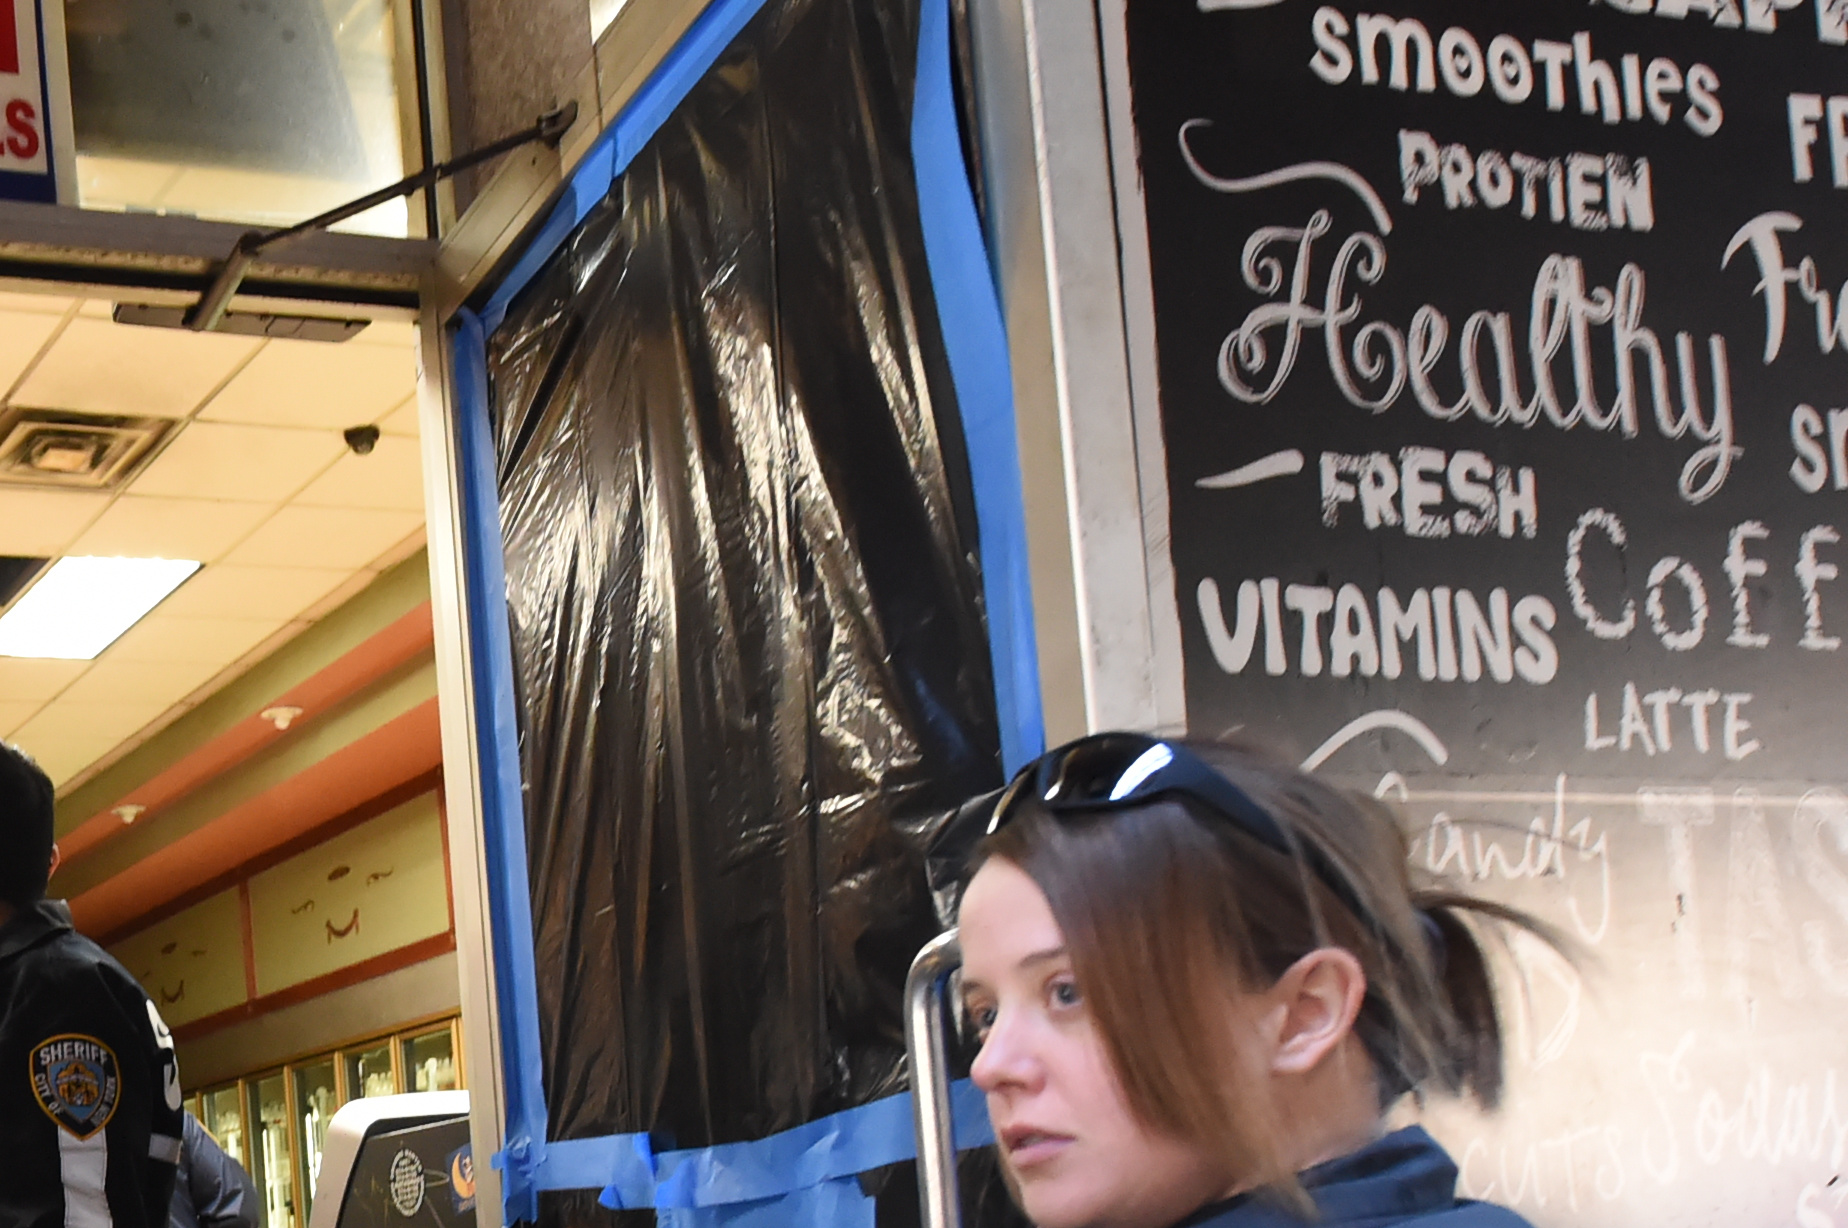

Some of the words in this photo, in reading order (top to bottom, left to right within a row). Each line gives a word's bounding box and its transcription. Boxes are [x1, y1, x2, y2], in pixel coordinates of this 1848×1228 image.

[1398, 128, 1654, 233] PROTIEN
[1217, 208, 1744, 505] Healthy
[1319, 446, 1538, 539] FRESH
[1196, 576, 1559, 685] VITAMINS
[1584, 680, 1762, 762] LATTE
[34, 1072, 53, 1099] CITY
[48, 1101, 63, 1117] OF
[39, 1040, 108, 1067] SHERIFF
